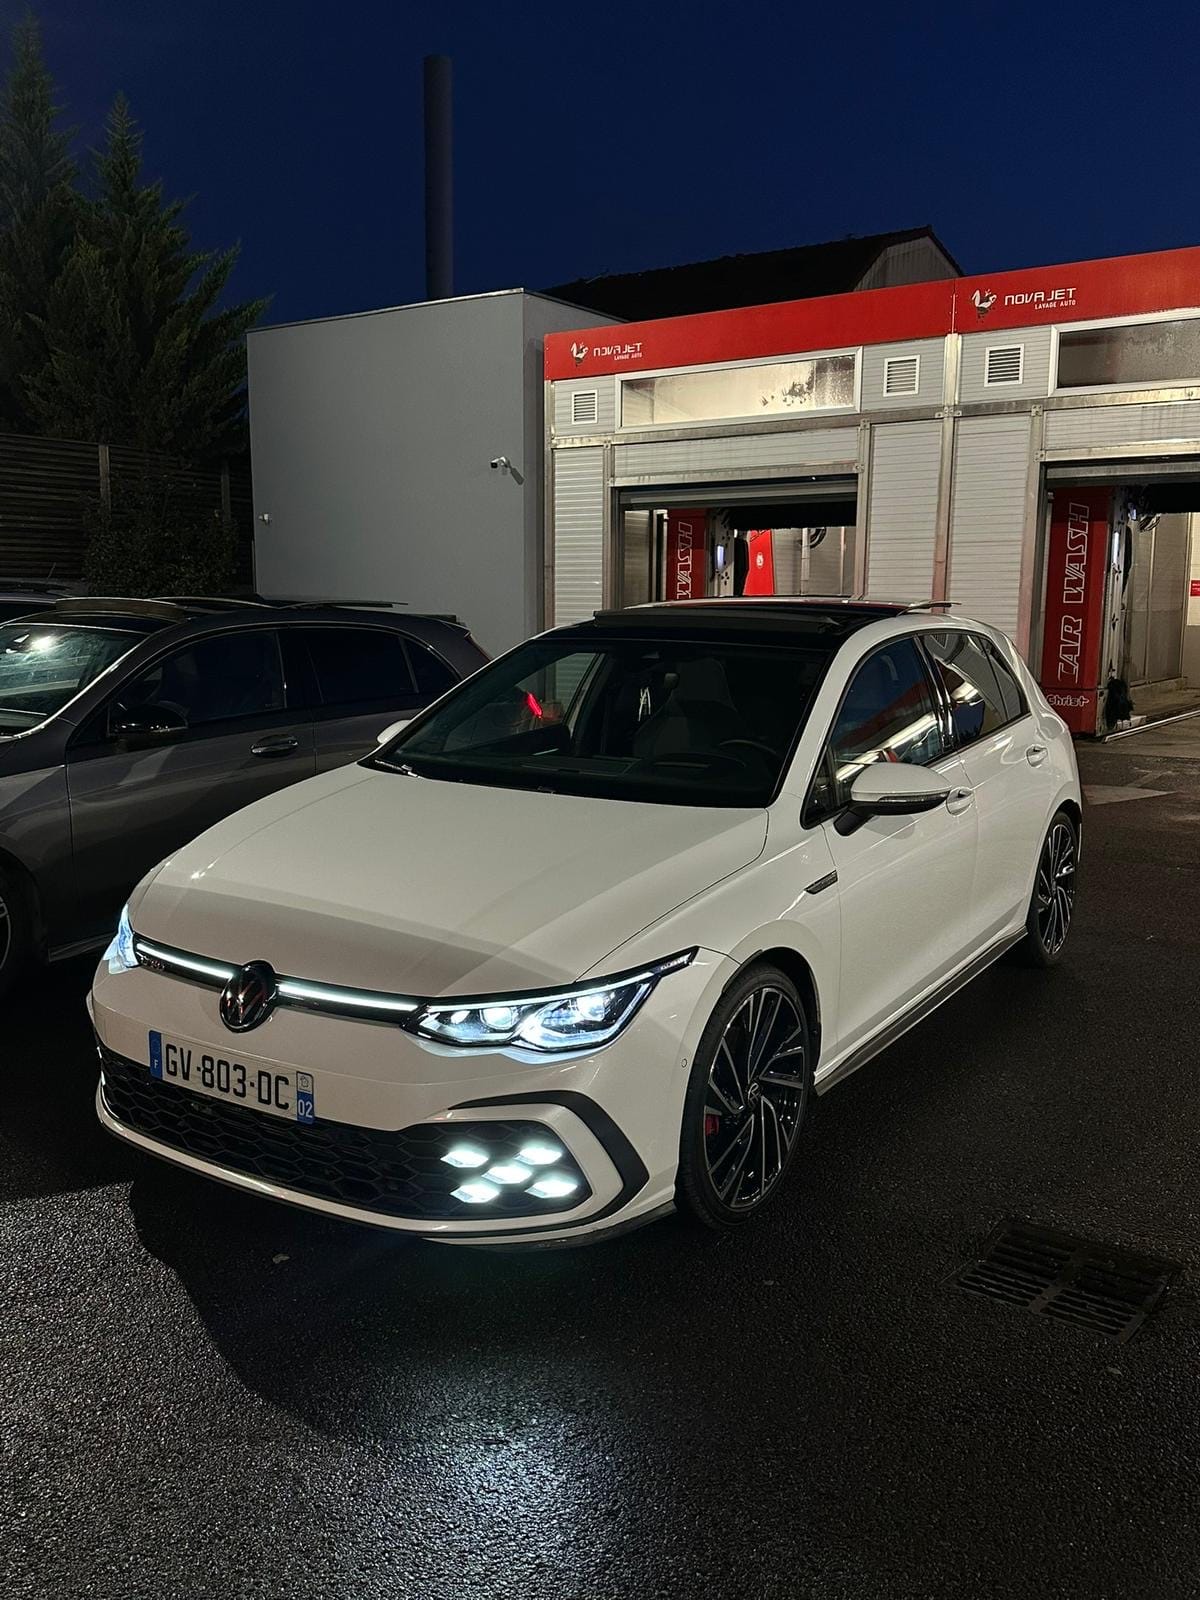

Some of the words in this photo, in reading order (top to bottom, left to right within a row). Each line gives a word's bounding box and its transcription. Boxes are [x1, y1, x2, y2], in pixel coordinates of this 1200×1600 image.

[1034, 301, 1057, 310] LAVAGE
[1059, 299, 1076, 307] AUTO
[676, 521, 693, 600] WASH
[1063, 502, 1090, 604] WASH
[1046, 694, 1090, 707] Christ
[153, 1059, 159, 1069] F
[165, 1043, 290, 1111] GV-803-DC
[297, 1099, 314, 1118] 02
